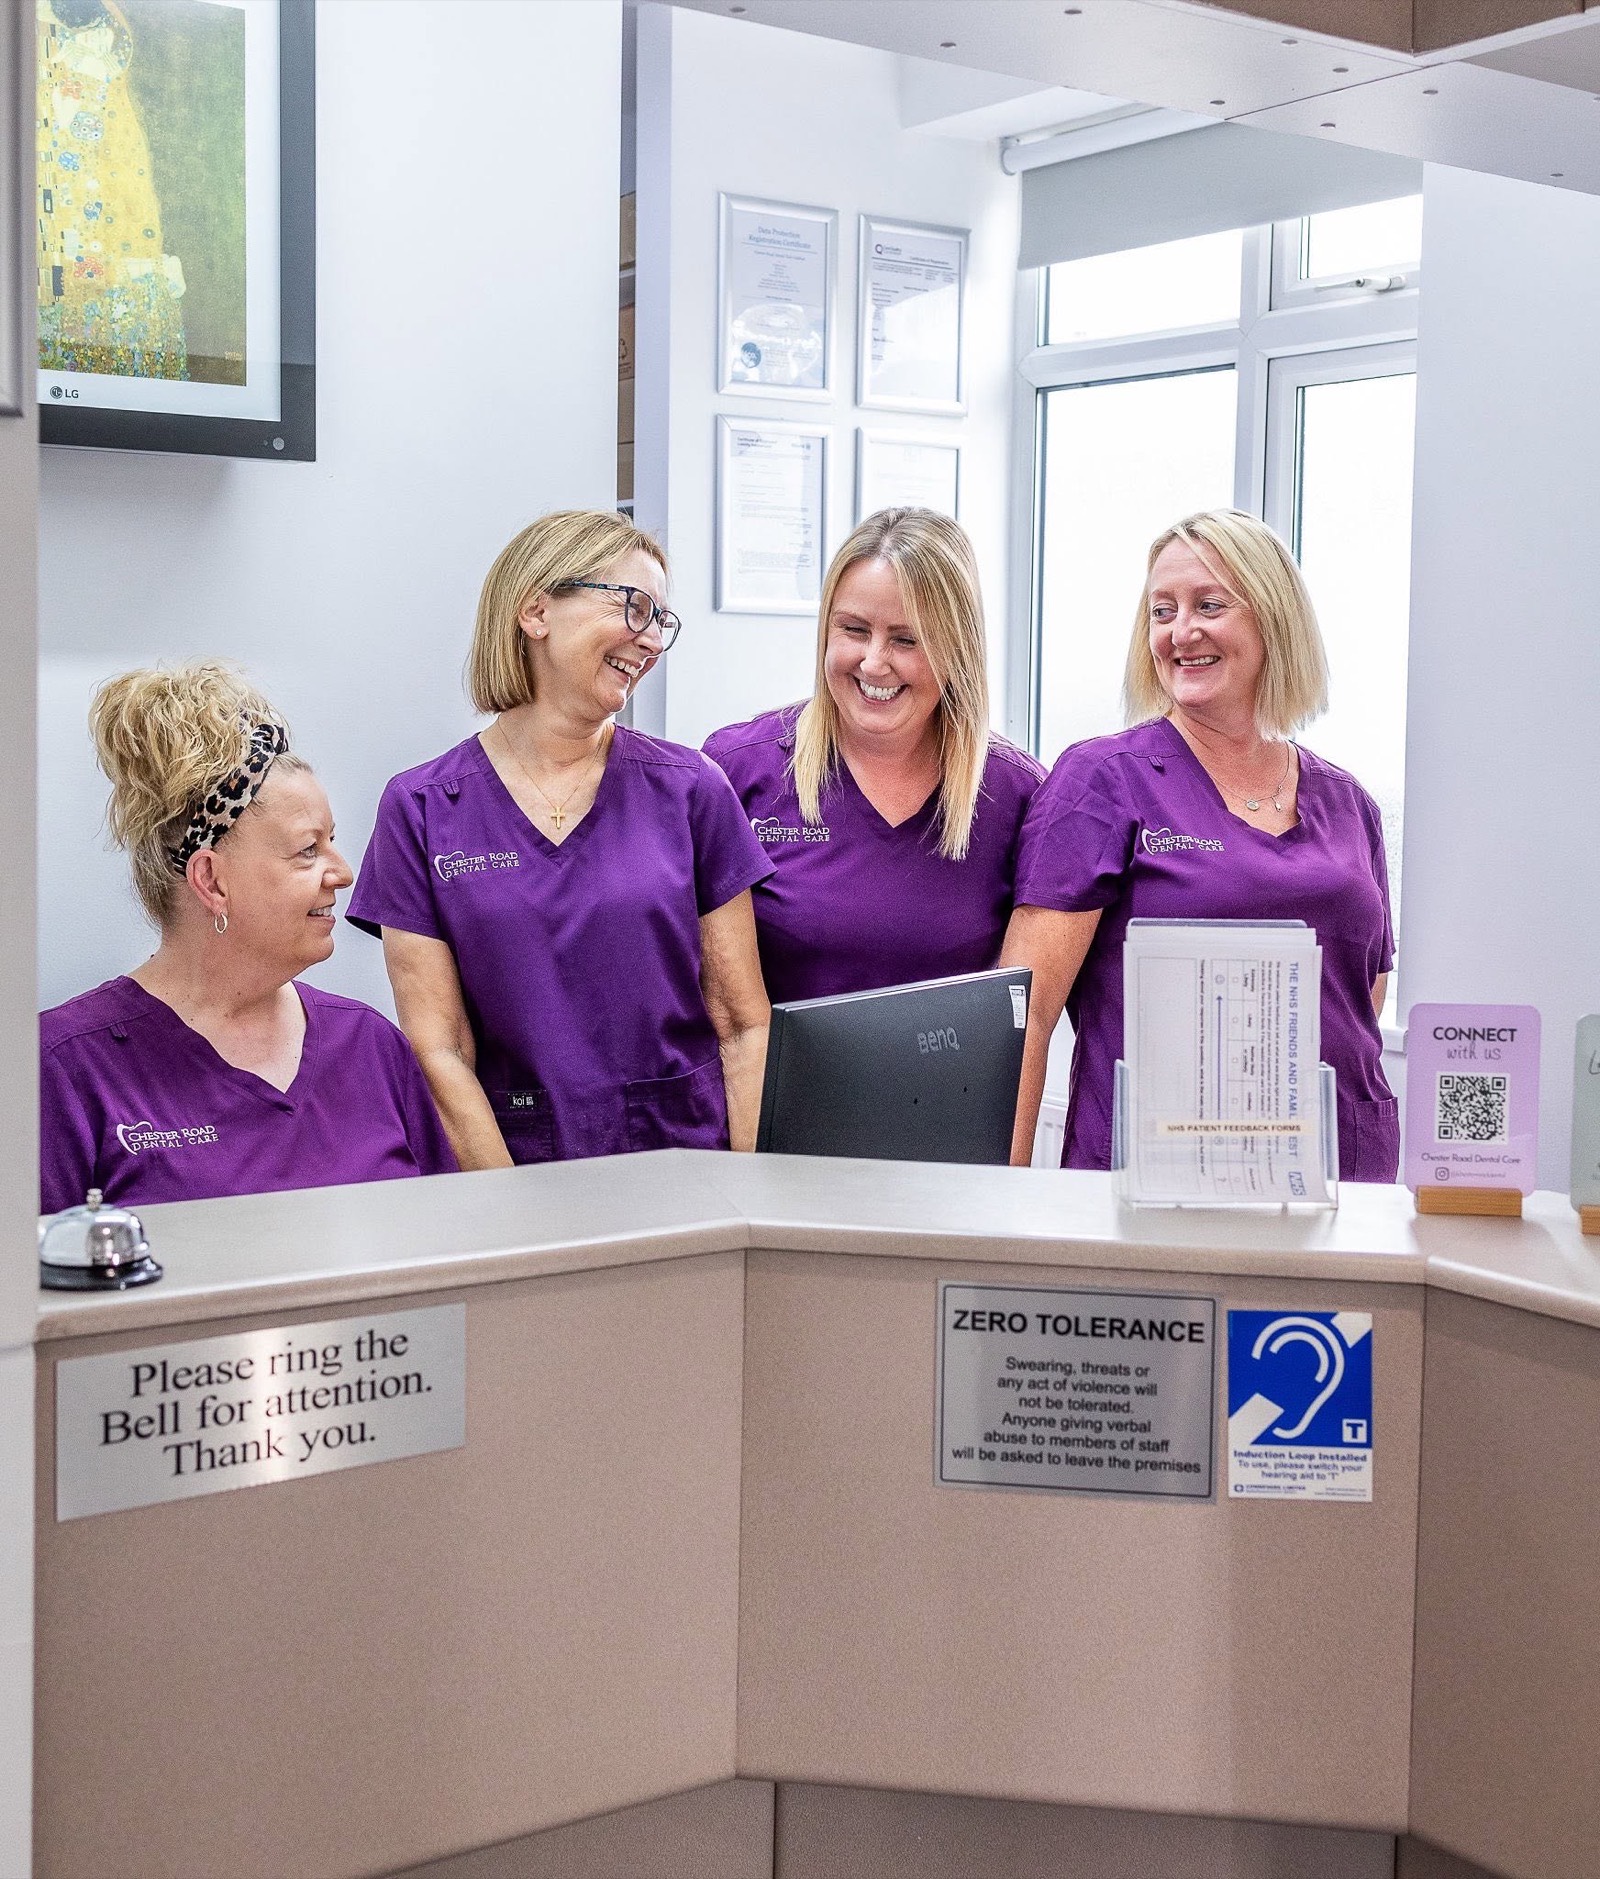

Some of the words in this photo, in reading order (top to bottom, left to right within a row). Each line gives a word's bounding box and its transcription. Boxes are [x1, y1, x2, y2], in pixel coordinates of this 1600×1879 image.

[65, 389, 79, 398] LG
[757, 826, 800, 836] CHESTER
[802, 827, 830, 836] ROAD
[1150, 835, 1194, 846] CHESTER
[1194, 838, 1222, 846] ROAD
[1151, 843, 1194, 852] DENTAL
[443, 855, 486, 870] CHESTER
[489, 852, 518, 861] ROAD
[445, 864, 487, 878] DENTAL
[492, 860, 520, 868] CARE
[1288, 962, 1299, 983] THE
[1288, 986, 1299, 1009] NHS
[1288, 1012, 1299, 1058] FRIENDS
[1433, 1027, 1517, 1042] CONNECT
[1447, 1043, 1477, 1060] with
[1485, 1047, 1501, 1060] us
[1288, 1060, 1299, 1085] AND
[128, 1131, 181, 1142] CHESTER
[181, 1125, 215, 1138] ROAD
[131, 1140, 183, 1152] DENTAL
[188, 1133, 219, 1145] CARE
[1288, 1136, 1298, 1157] EST
[1421, 1153, 1449, 1162] Chester
[1452, 1153, 1472, 1162] Road
[1475, 1154, 1500, 1163] Dental
[1502, 1155, 1522, 1164] Care
[952, 1309, 1027, 1334] ZERO
[1035, 1313, 1205, 1343] TOLERANCE
[130, 1356, 254, 1399] Please
[269, 1341, 343, 1377] ring
[355, 1329, 409, 1362] the
[1005, 1356, 1077, 1377] Swearing,
[1081, 1360, 1131, 1378] threats
[1135, 1365, 1150, 1378] or
[997, 1377, 1022, 1392] any
[1027, 1378, 1050, 1391] act
[1053, 1379, 1067, 1392] of
[1071, 1380, 1130, 1396] violence
[1134, 1382, 1158, 1397] will
[100, 1401, 181, 1446] Bell
[196, 1395, 249, 1430] for
[265, 1369, 433, 1418] attention.
[1018, 1396, 1042, 1409] not
[1046, 1396, 1063, 1410] be
[1067, 1397, 1134, 1414] tolerated.
[1001, 1412, 1056, 1431] Anyone
[1060, 1416, 1102, 1433] giving
[1107, 1419, 1152, 1433] verbal
[1346, 1422, 1364, 1439] T
[163, 1428, 285, 1477] Thank
[299, 1421, 376, 1462] you.
[983, 1430, 1027, 1445] abuse
[1031, 1432, 1046, 1446] to
[1050, 1433, 1116, 1450] members
[1120, 1436, 1135, 1451] of
[1138, 1437, 1170, 1453] staff
[952, 1447, 974, 1460] will
[978, 1448, 996, 1462] be
[1000, 1449, 1043, 1464] asked
[1048, 1452, 1061, 1466] to
[1065, 1453, 1104, 1468] leave
[1108, 1455, 1130, 1470] the
[1134, 1457, 1201, 1474] premises
[1233, 1450, 1286, 1459] Induction
[1288, 1451, 1315, 1461] Loop
[1318, 1452, 1367, 1462] Installed
[1238, 1459, 1249, 1468] To
[1273, 1461, 1305, 1470] please
[1307, 1462, 1339, 1471] switch
[1341, 1465, 1363, 1473] your
[1261, 1470, 1297, 1482] hearing
[1299, 1472, 1314, 1480] aid
[1316, 1472, 1327, 1481] to
